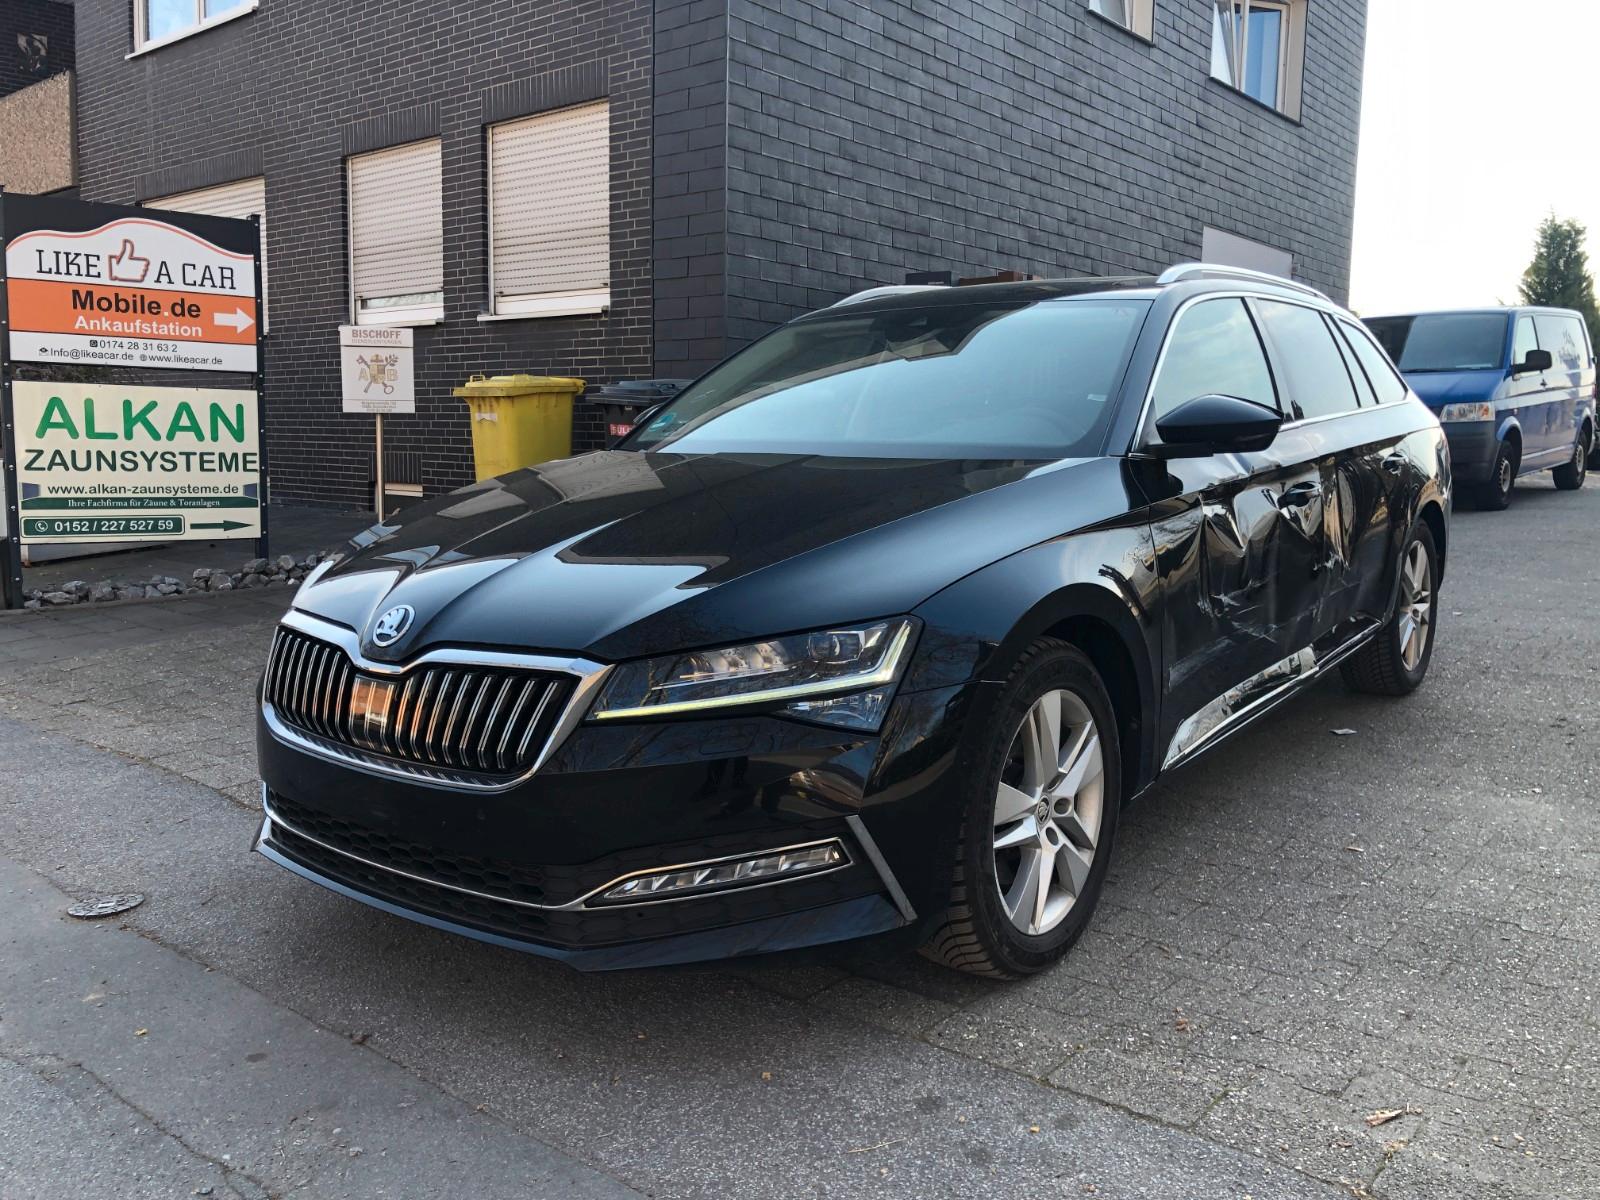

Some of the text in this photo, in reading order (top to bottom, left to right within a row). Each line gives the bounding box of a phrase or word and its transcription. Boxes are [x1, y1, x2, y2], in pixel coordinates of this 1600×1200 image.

[36, 249, 237, 290] LIKE A CAR
[72, 289, 201, 318] Mobile.de
[75, 315, 202, 337] Ankaufstation
[352, 329, 401, 339] BISCHOFF
[100, 340, 178, 352] 0174 28 31 63 2
[50, 348, 223, 365] Info@likeacar.de www.likeacar.de
[35, 396, 245, 443] ALKAN
[24, 449, 259, 473] ZAUNSYSTEME
[47, 484, 239, 497] www.alkan-zaunsysteme.de
[68, 499, 85, 507] Ihre
[87, 499, 127, 507] Fachfirma
[129, 499, 141, 507] für
[143, 498, 168, 507] Zäune
[178, 499, 221, 508] Toranlagen
[54, 521, 90, 532] 0152
[101, 520, 127, 532] 227
[129, 520, 154, 531] 527
[158, 519, 174, 530] 59
